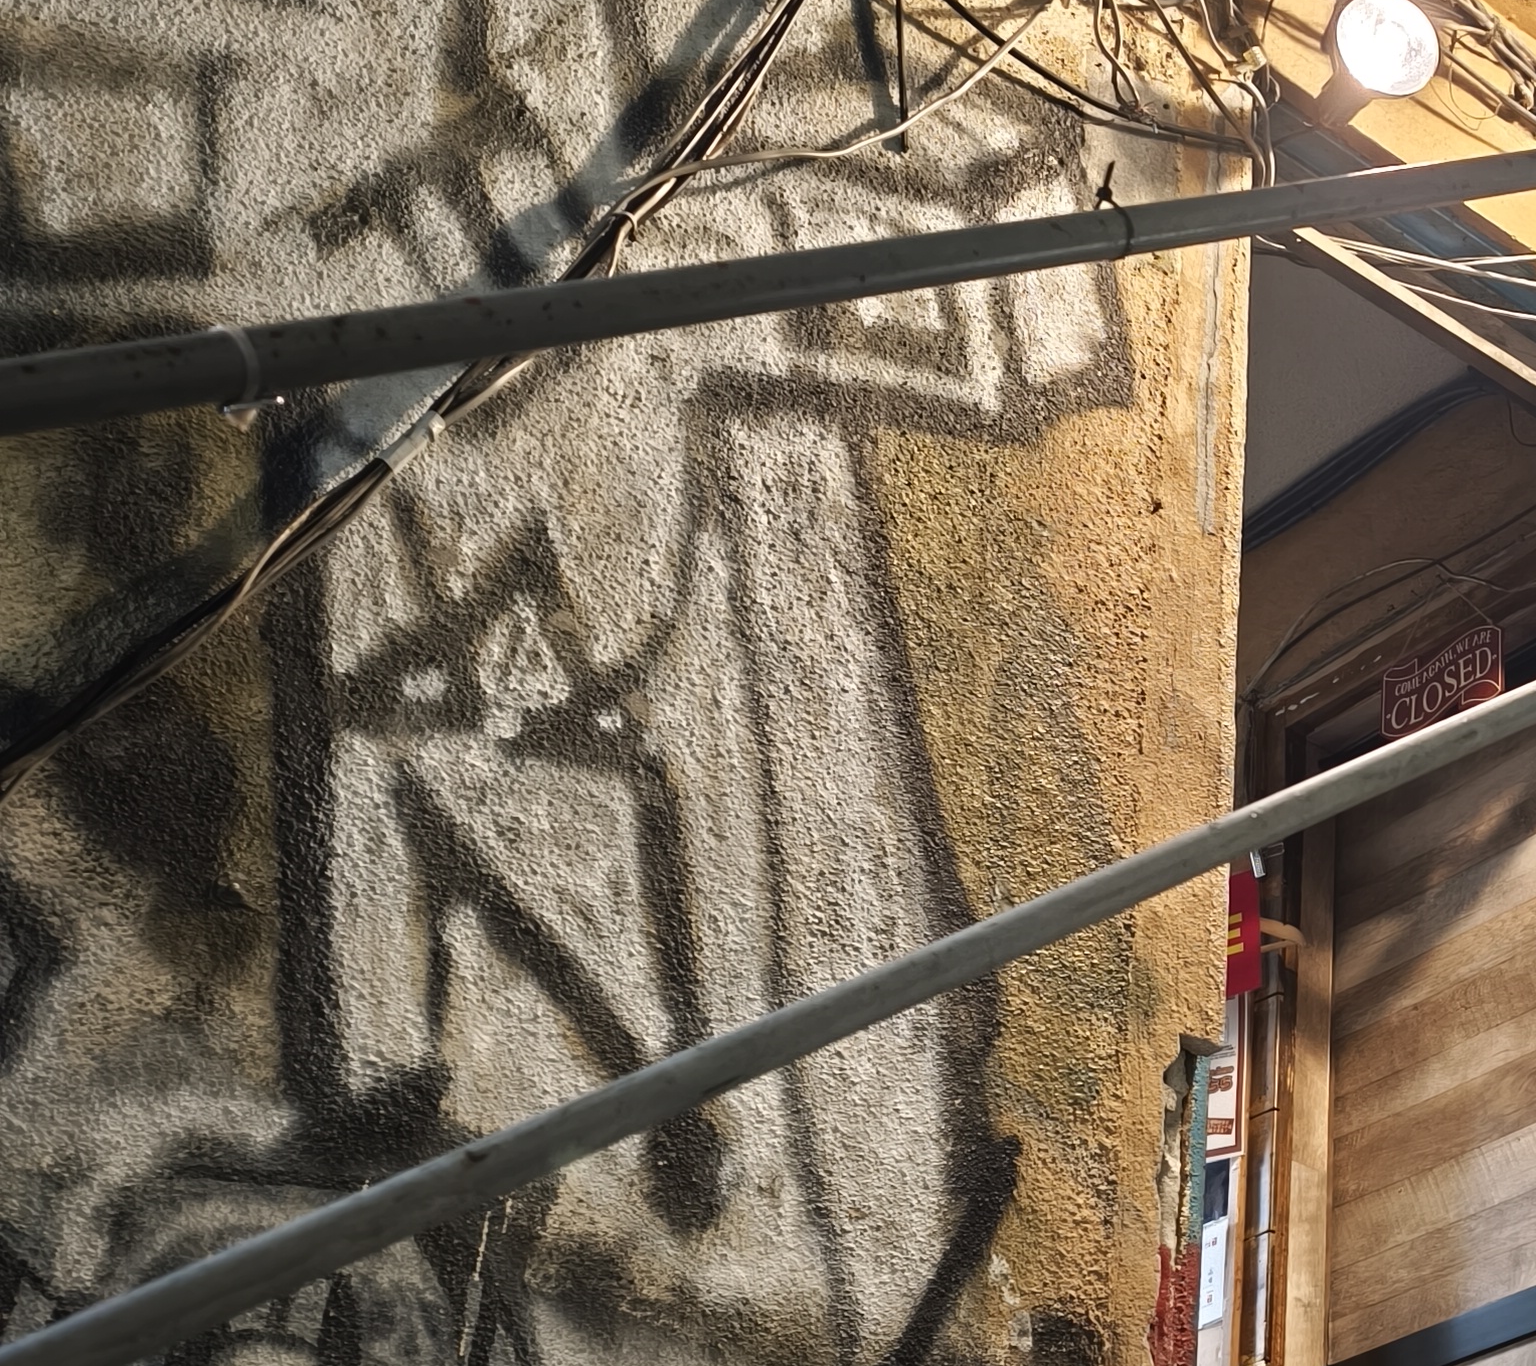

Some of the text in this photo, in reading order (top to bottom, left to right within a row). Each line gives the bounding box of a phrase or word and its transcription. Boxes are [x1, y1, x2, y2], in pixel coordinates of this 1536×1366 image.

[1391, 647, 1492, 729] CLOSED
[1395, 630, 1492, 696] COME AGAIN, WE ARE
